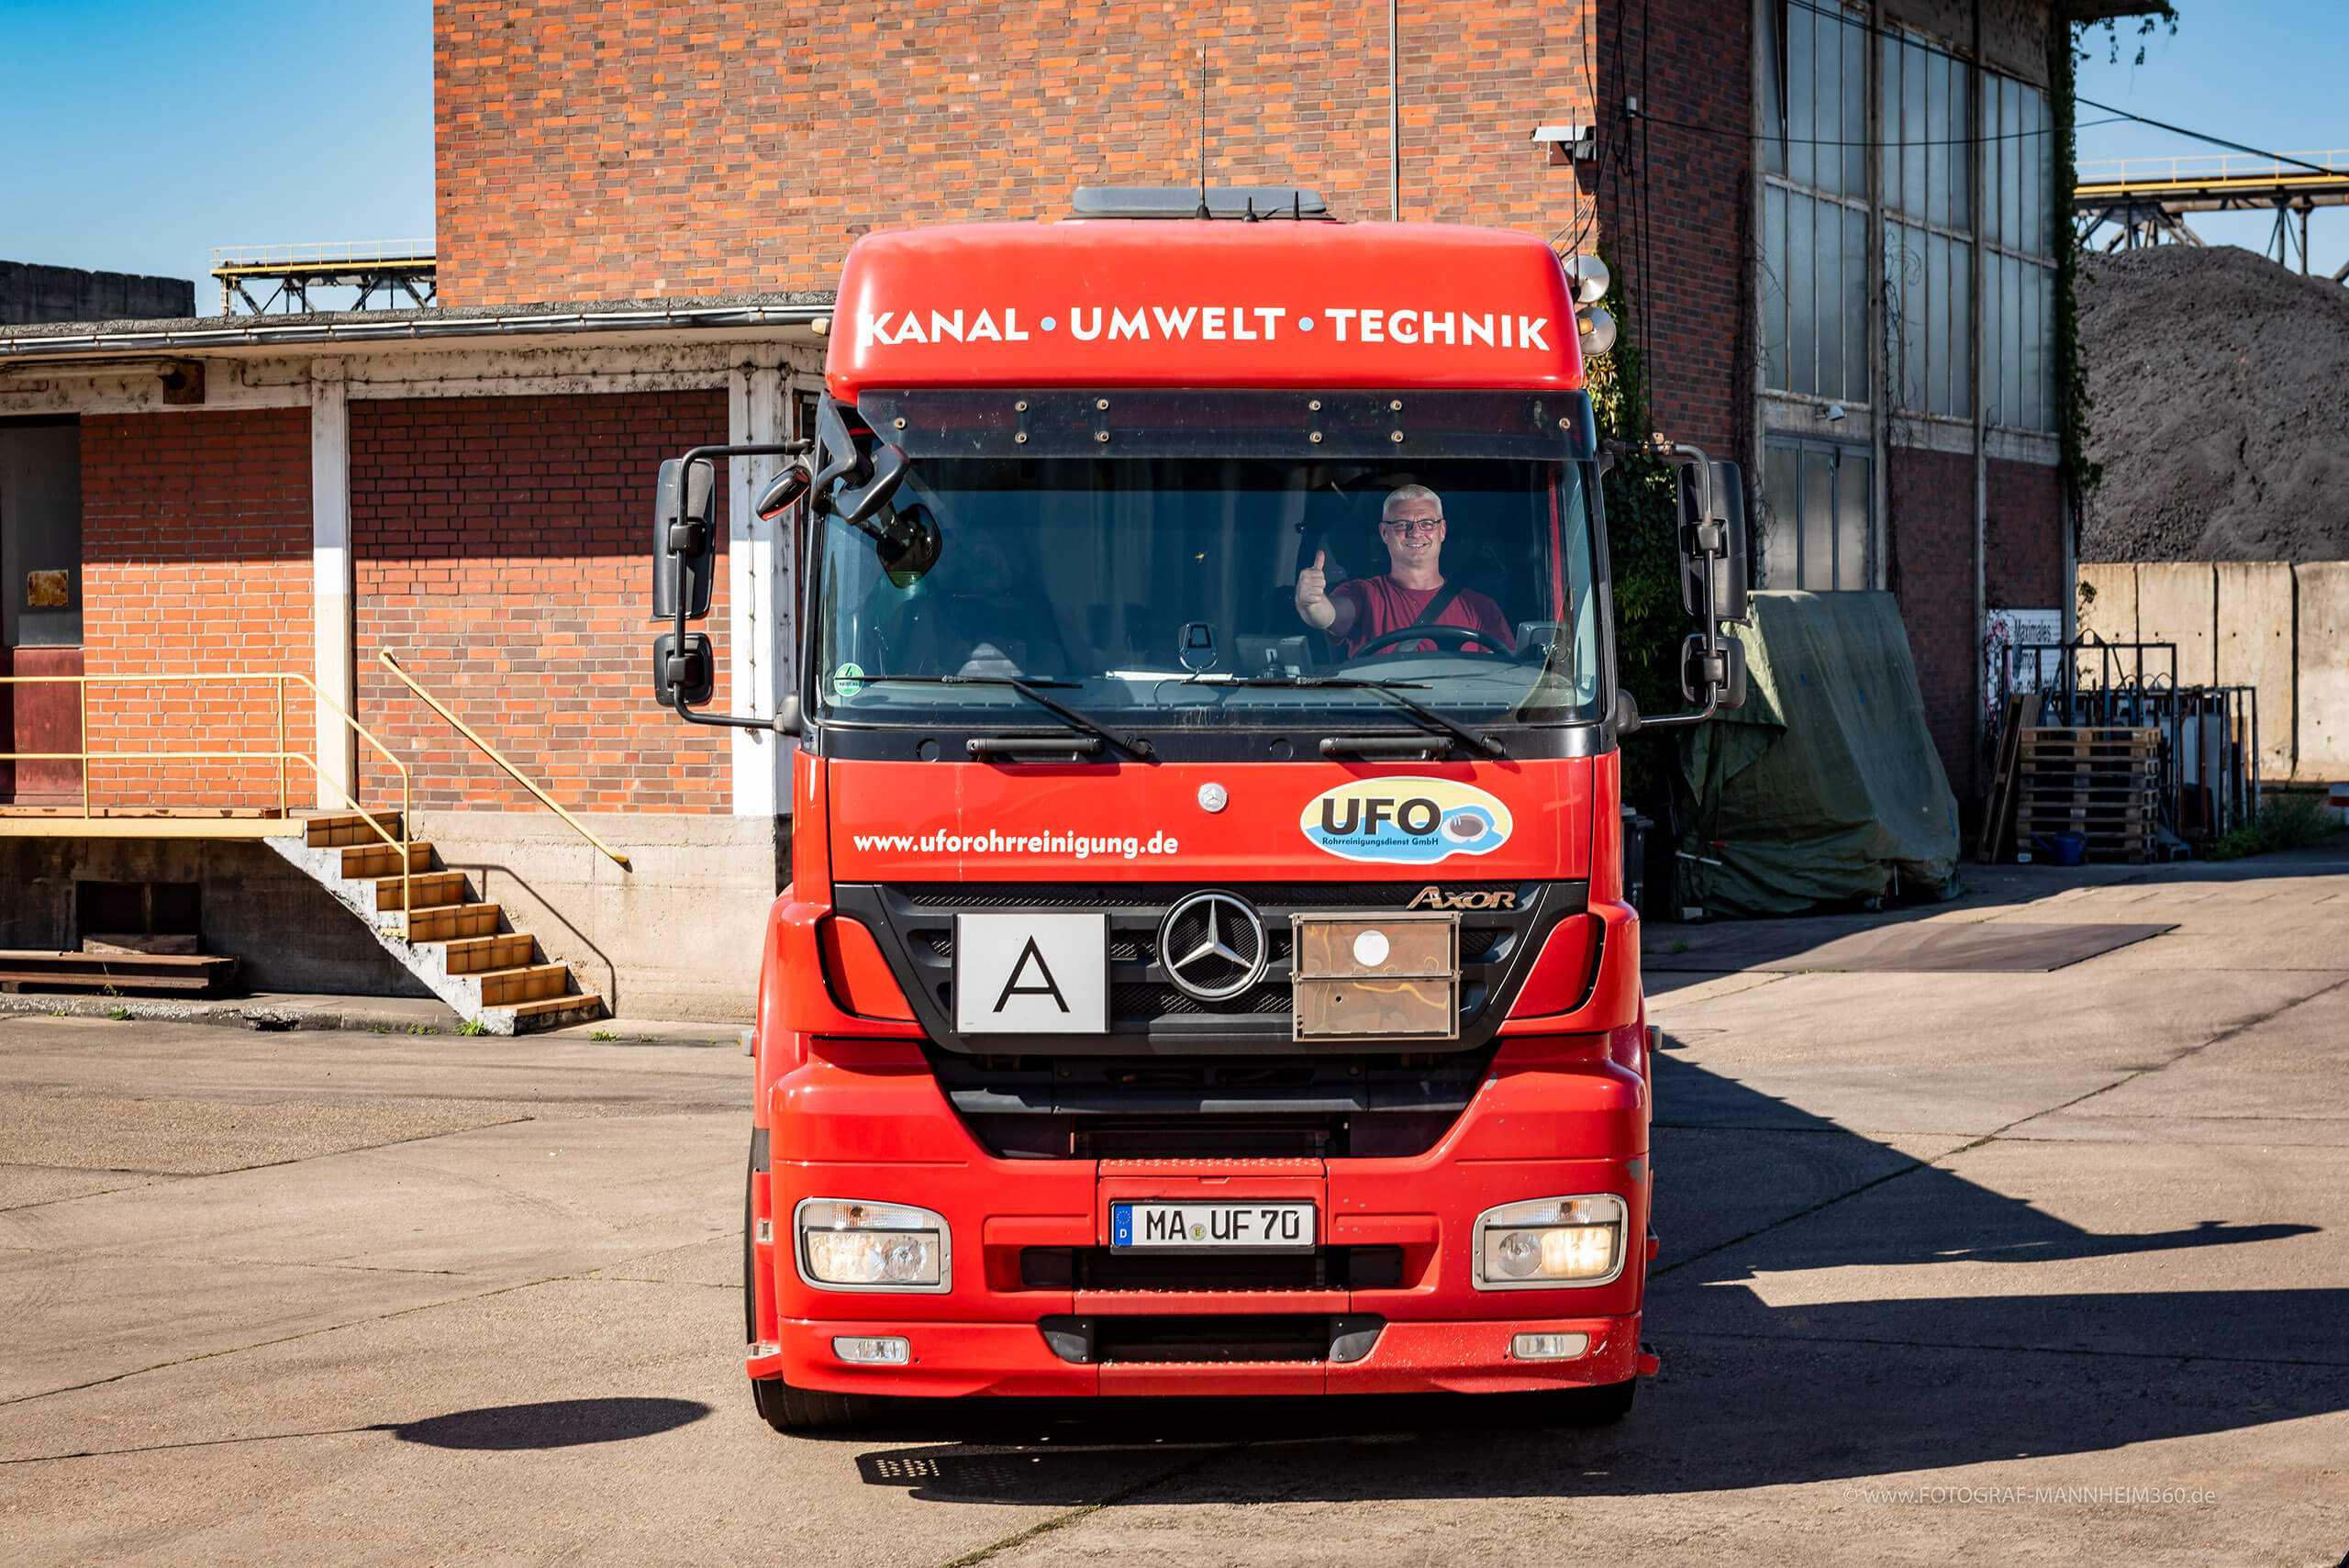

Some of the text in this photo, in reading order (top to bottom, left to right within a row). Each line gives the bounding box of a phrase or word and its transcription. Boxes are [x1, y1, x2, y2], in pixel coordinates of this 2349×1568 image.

[864, 306, 1550, 350] KANAL UMWELT TECHNIK
[2014, 619, 2052, 643] Maximales
[1321, 797, 1442, 836] UFO
[853, 828, 1179, 860] www.uforohrreinigung.de
[1322, 838, 1439, 847] Rohrreinigungsdienst GmbH
[992, 934, 1071, 1013] A
[1119, 1229, 1128, 1239] D
[1146, 1210, 1299, 1240] MA UF 70
